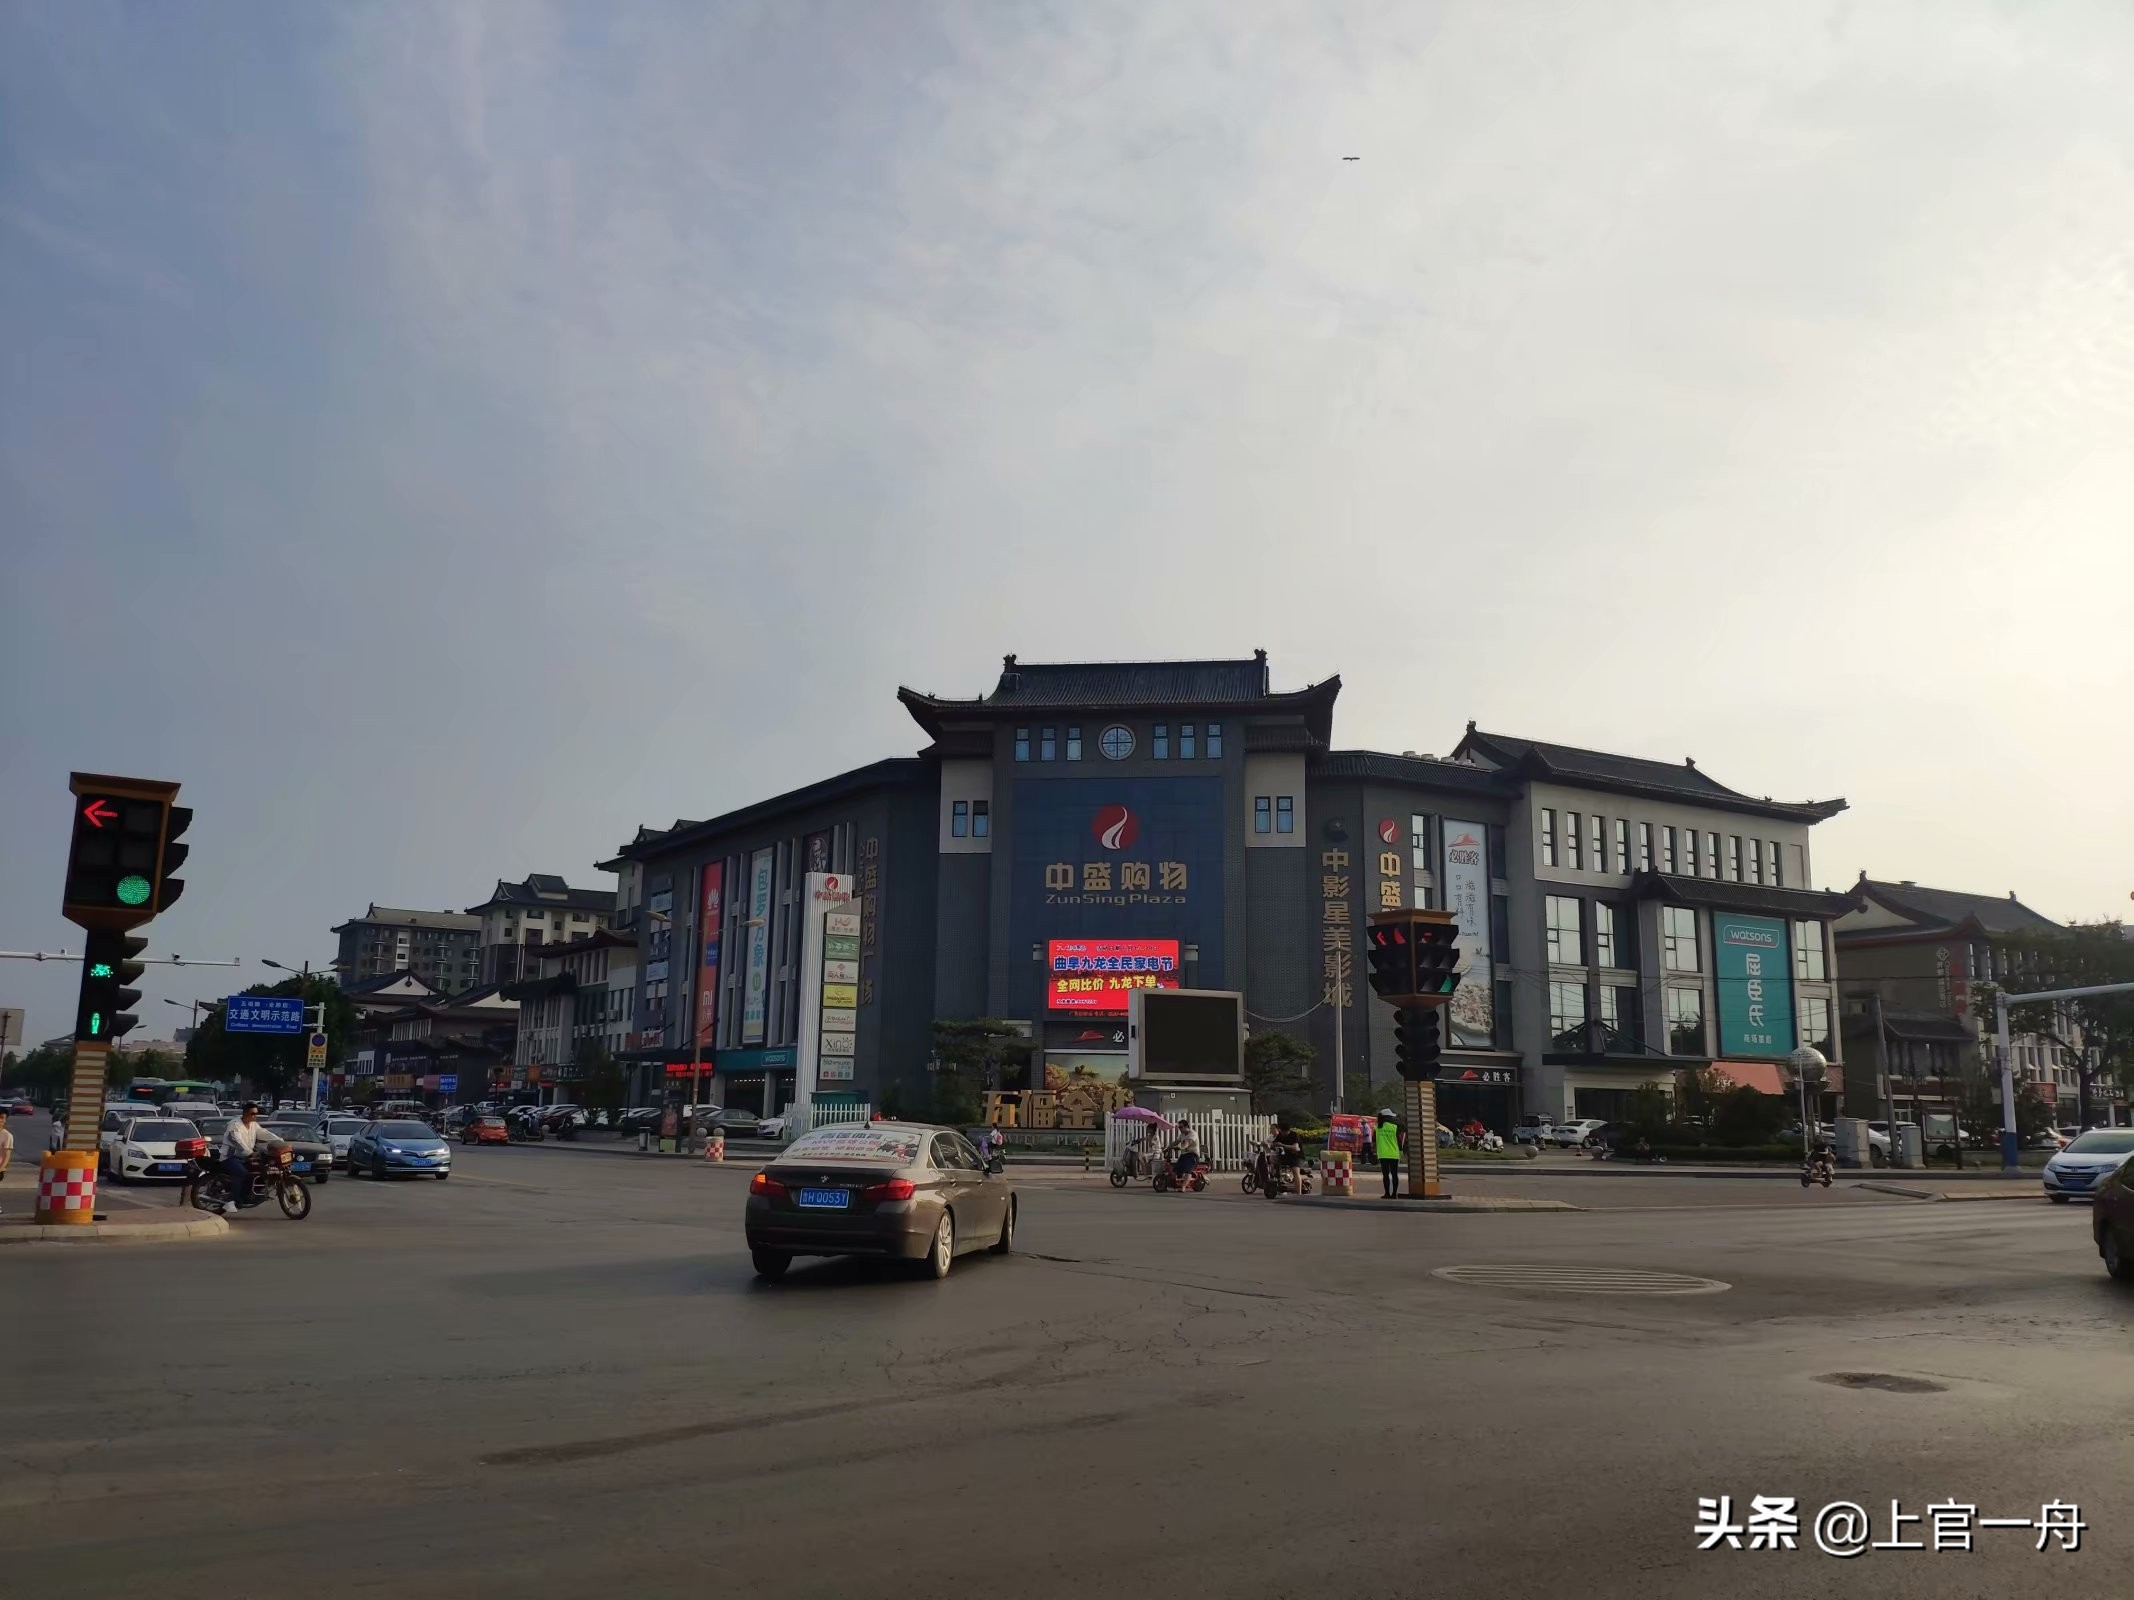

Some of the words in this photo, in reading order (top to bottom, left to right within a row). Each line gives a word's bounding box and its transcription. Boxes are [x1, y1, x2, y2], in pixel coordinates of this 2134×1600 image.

[1046, 862, 1187, 890] 中盛购物
[1379, 851, 1402, 911] 中盛
[1046, 894, 1126, 905] ZunSing
[1129, 893, 1187, 904] Plaza
[1322, 848, 1353, 1008] 中影星美影城
[1730, 929, 1772, 943] watsons
[1054, 957, 1174, 971] 曲阜九龙全民家电节
[1057, 978, 1104, 993] 全网比价
[1109, 975, 1158, 990] 九龙下单
[229, 1009, 301, 1022] 交通文明示范路
[1482, 1071, 1511, 1083] 必胜客
